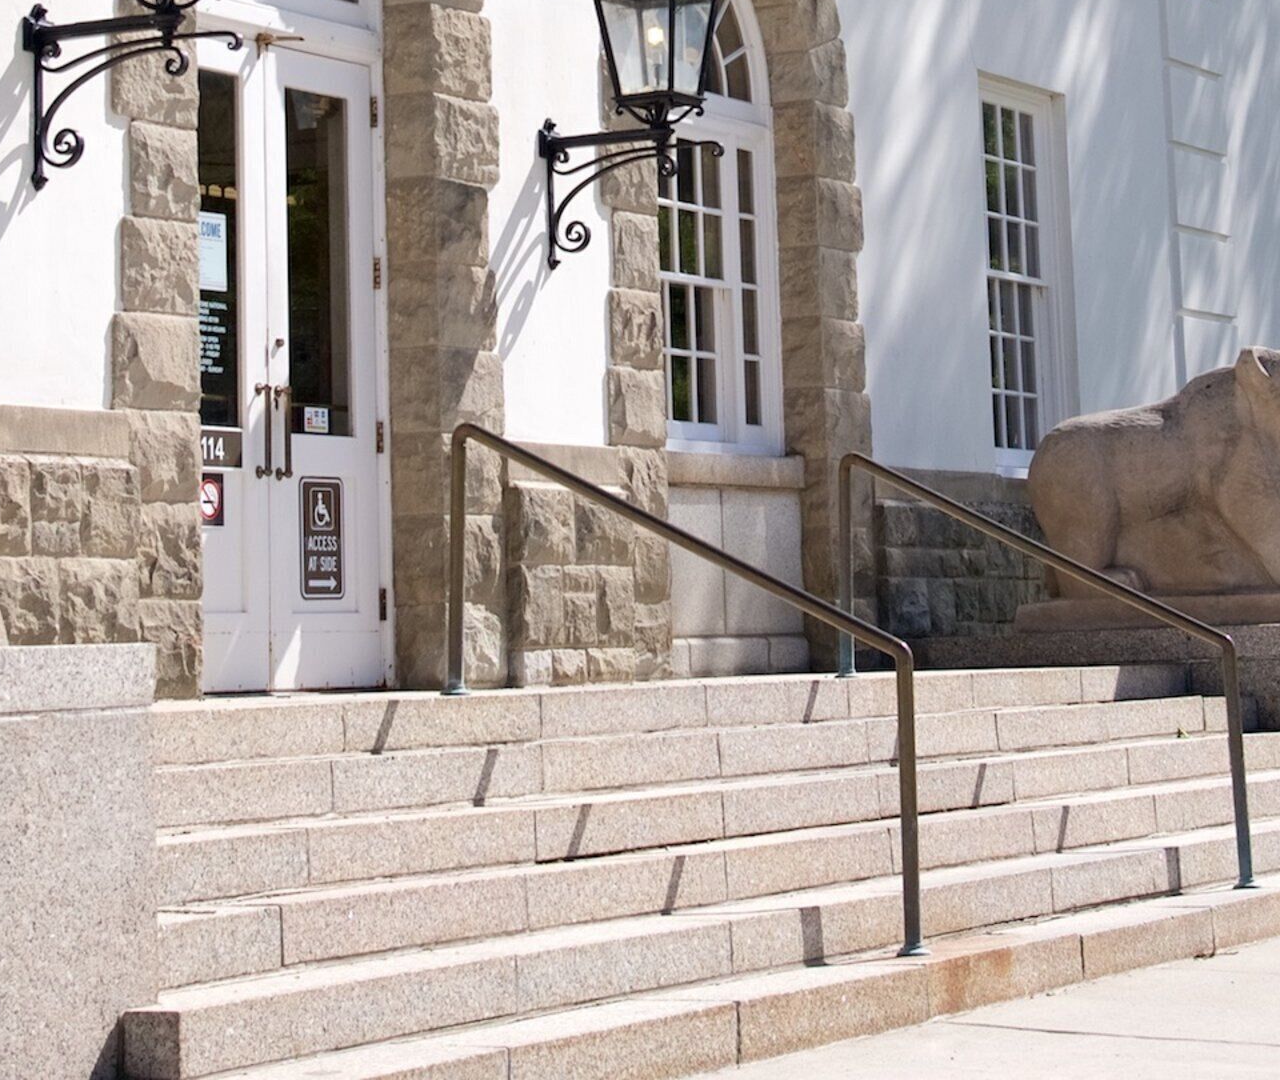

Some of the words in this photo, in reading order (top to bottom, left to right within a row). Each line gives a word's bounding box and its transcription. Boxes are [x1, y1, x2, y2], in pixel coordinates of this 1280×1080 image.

[199, 221, 222, 239] COME
[308, 536, 338, 551] ACCESS
[308, 556, 318, 572] AT
[320, 556, 338, 572] SIDE
